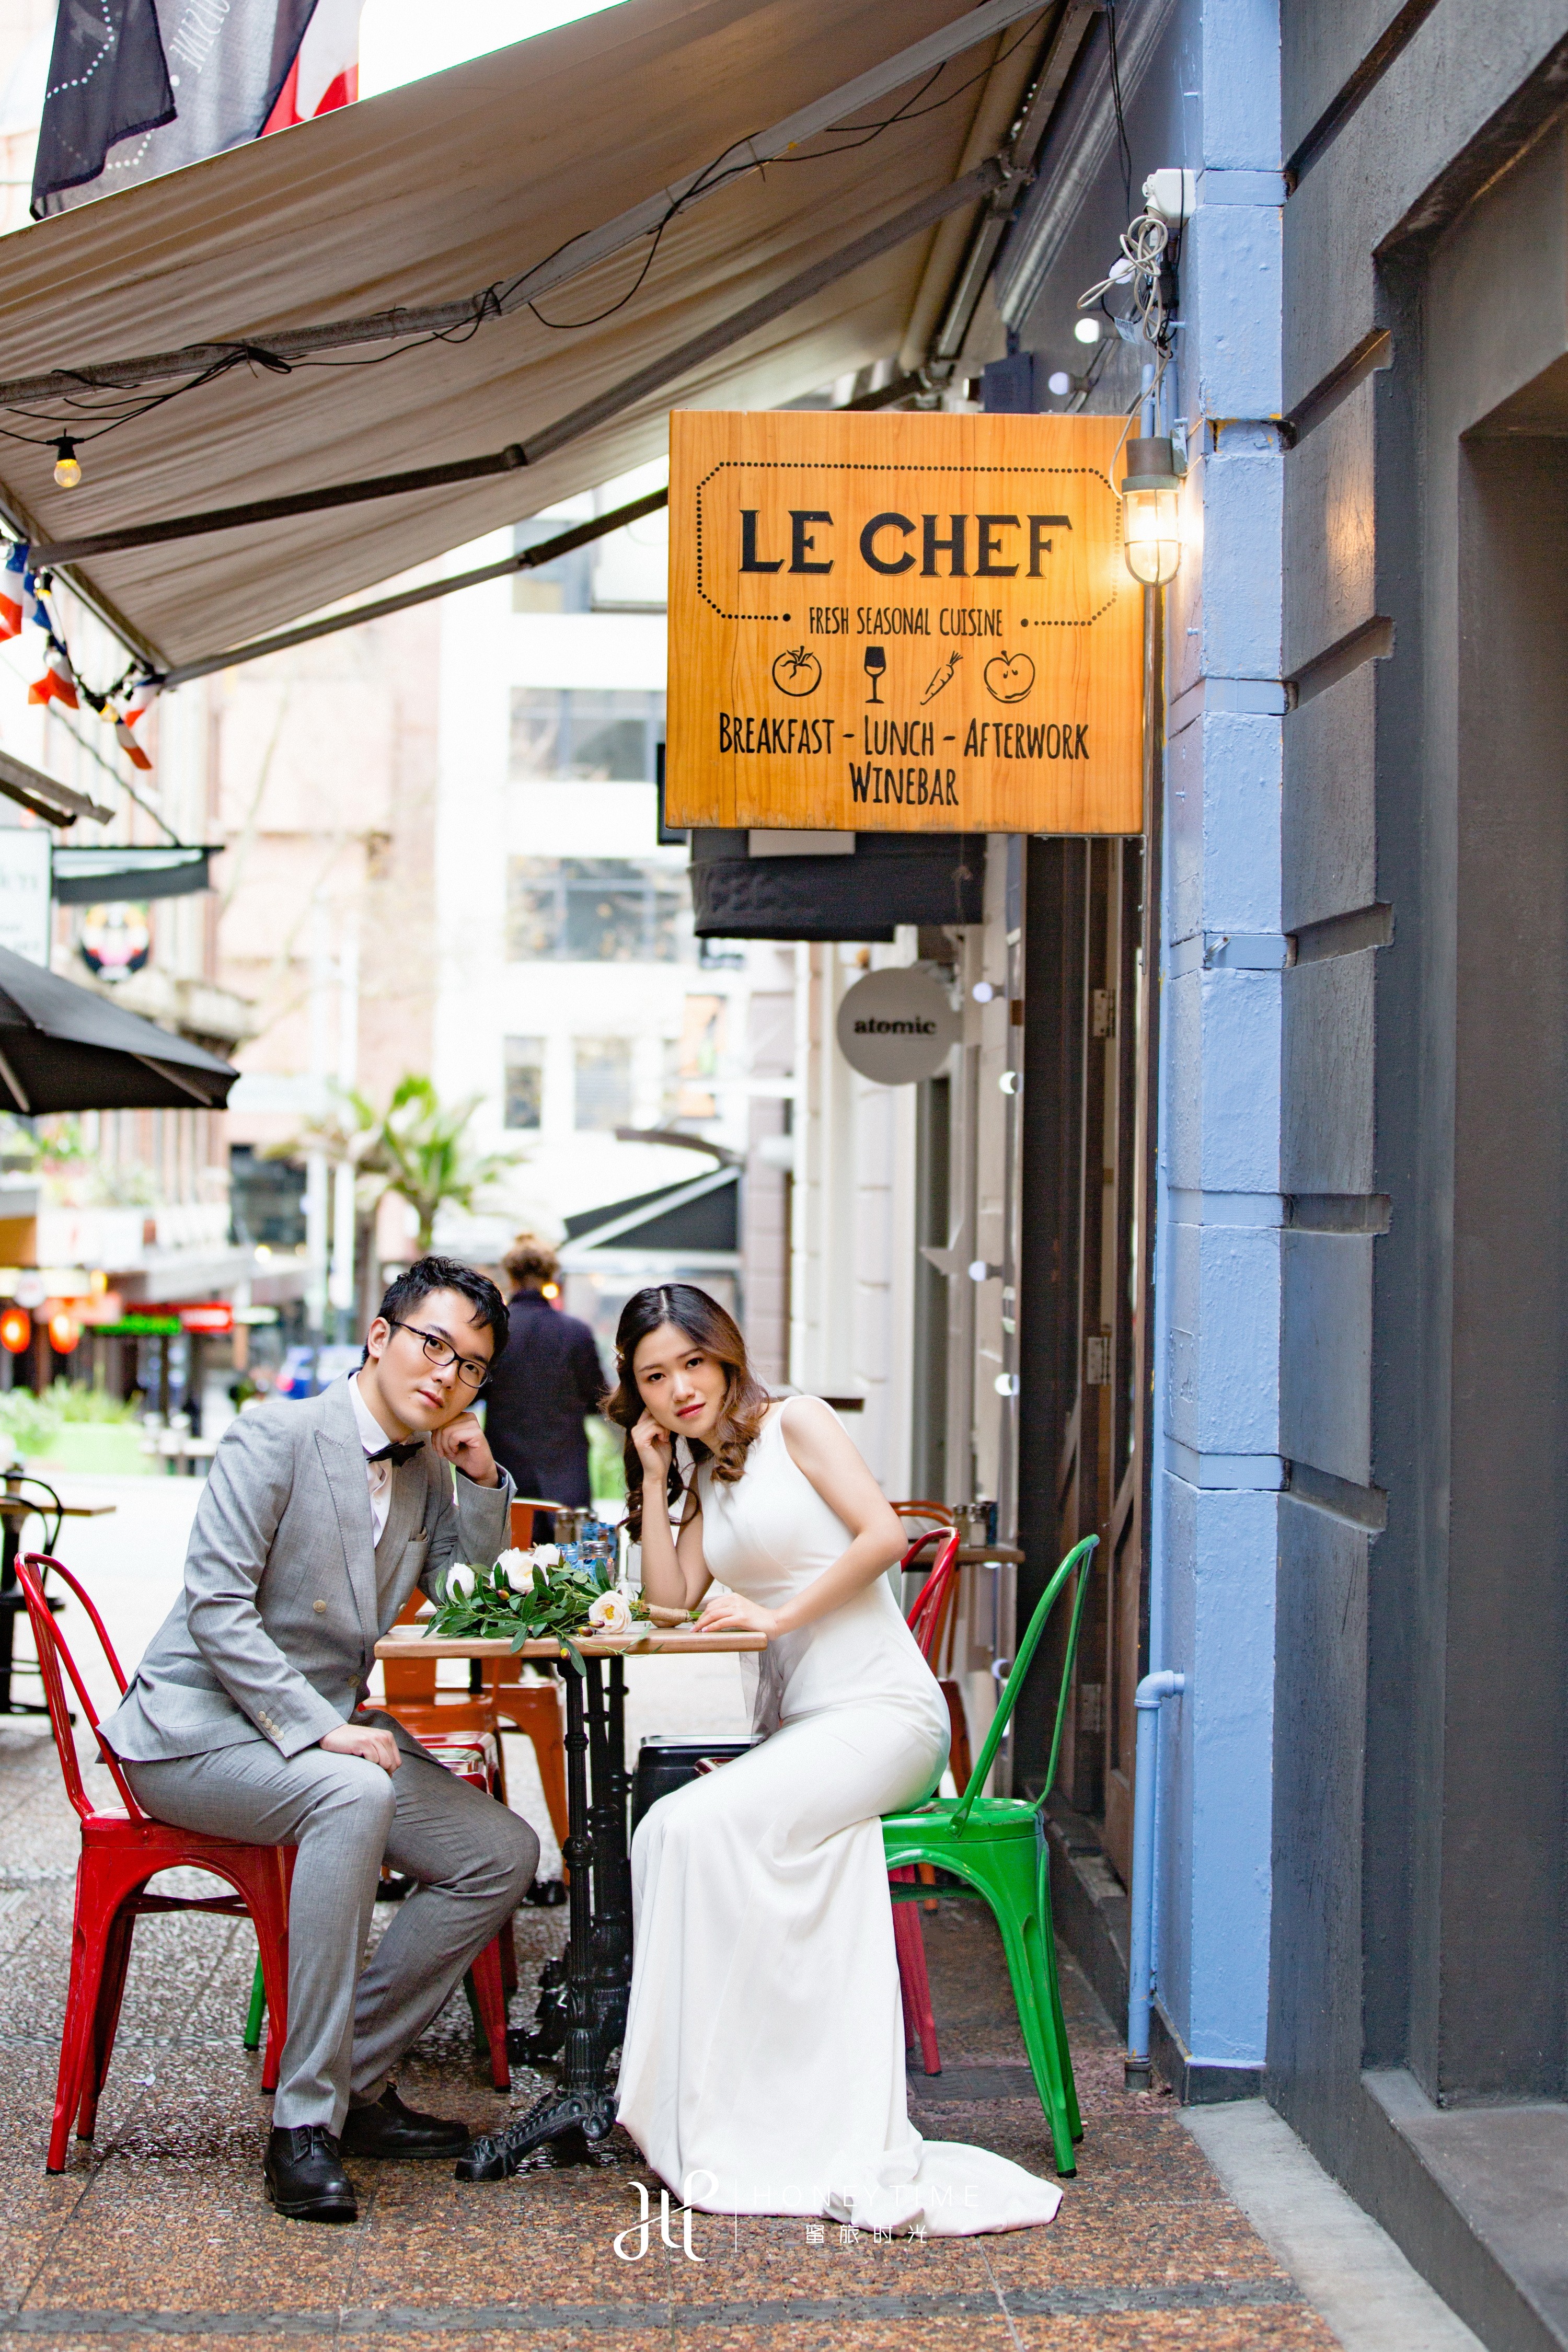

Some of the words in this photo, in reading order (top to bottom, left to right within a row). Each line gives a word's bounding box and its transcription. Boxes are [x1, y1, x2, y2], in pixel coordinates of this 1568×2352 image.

[738, 509, 834, 574] LE
[859, 512, 1073, 579] CHEF
[809, 607, 849, 635] FRESH
[856, 607, 931, 636] SEASONAL
[939, 608, 1002, 637] CUISINE
[719, 711, 835, 755] BREAKFAST
[864, 714, 934, 757] LUNCH
[963, 717, 1090, 760] AFTERWORK
[849, 761, 959, 806] WINEBAR
[854, 1016, 936, 1035] atomic
